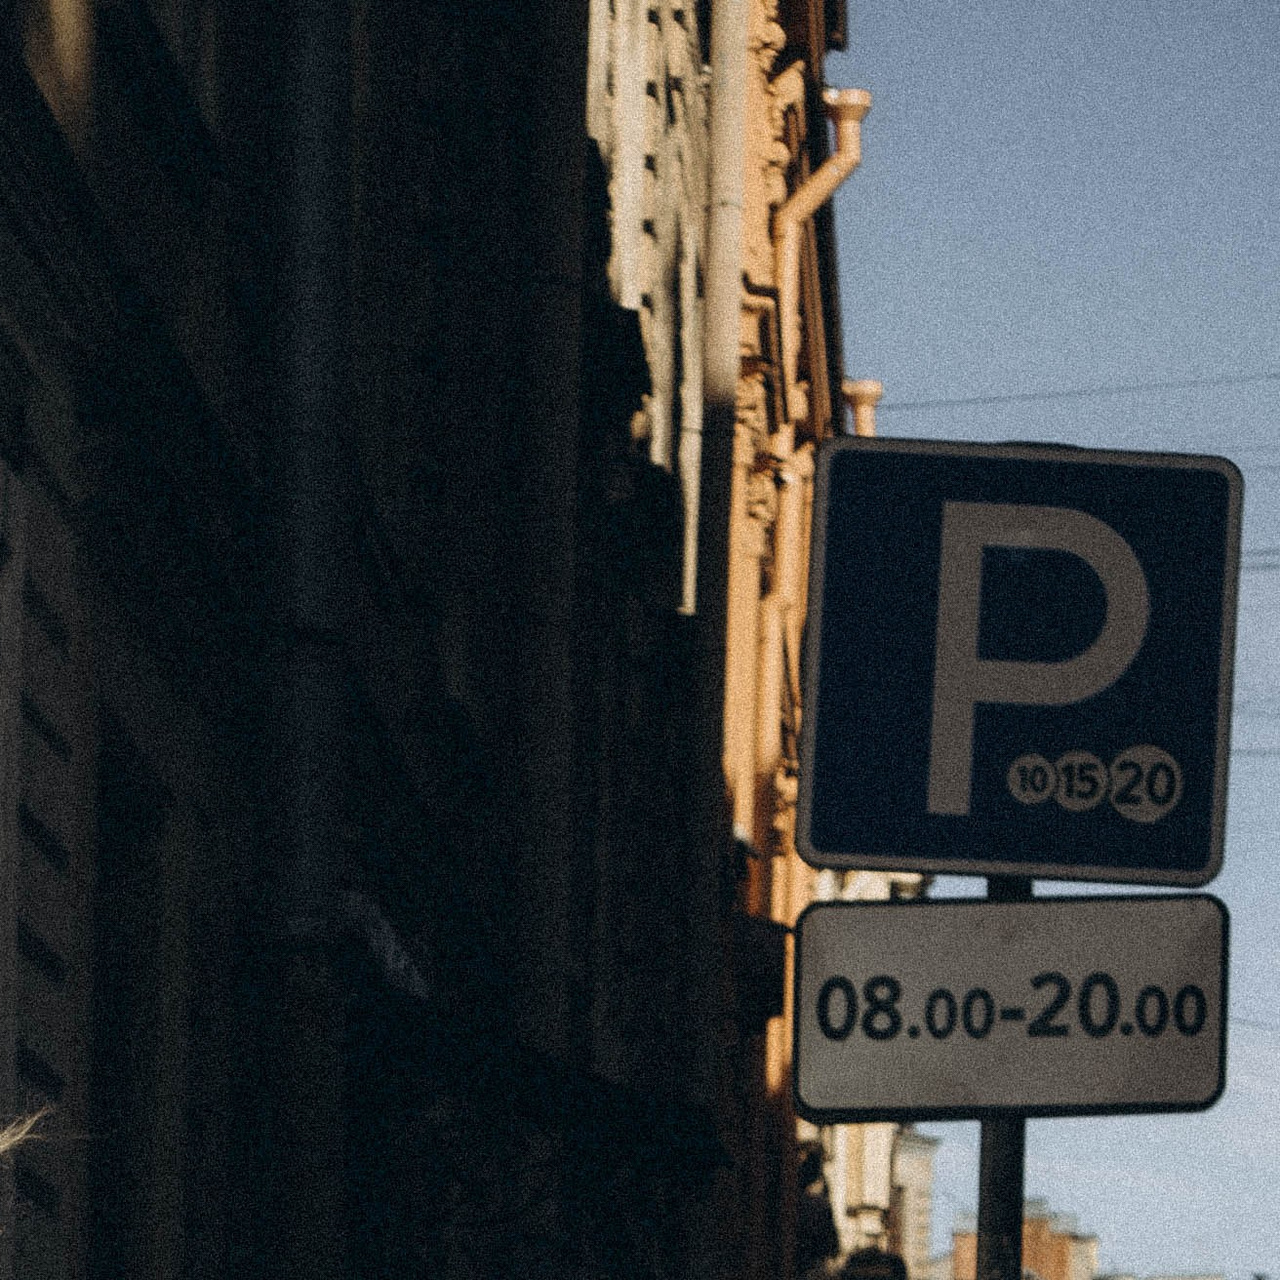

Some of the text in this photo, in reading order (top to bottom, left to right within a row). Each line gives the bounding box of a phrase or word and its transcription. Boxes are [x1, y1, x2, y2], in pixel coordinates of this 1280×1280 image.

[928, 501, 1150, 816] P
[1017, 760, 1176, 805] 10 15 20
[815, 972, 1211, 1042] 08.00-20.00
